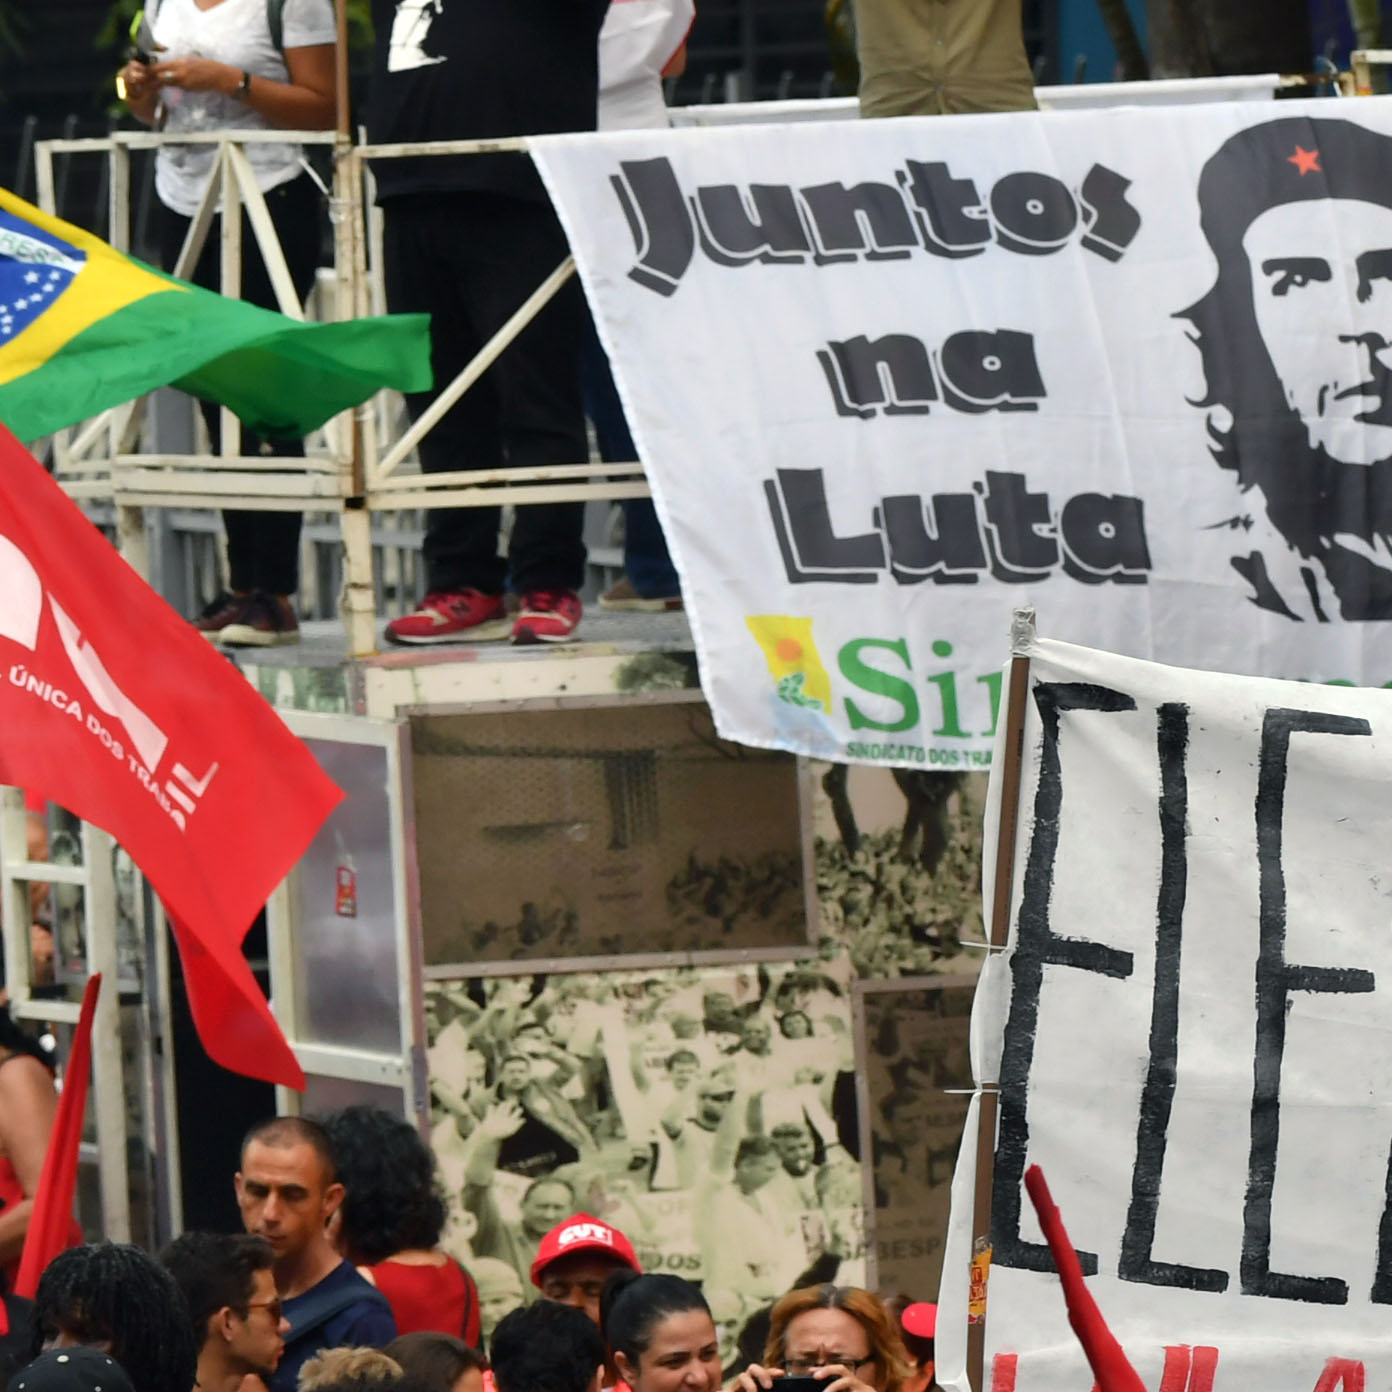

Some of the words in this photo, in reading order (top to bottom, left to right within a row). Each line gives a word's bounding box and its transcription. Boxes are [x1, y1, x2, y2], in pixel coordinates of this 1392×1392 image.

[609, 156, 1143, 297] Juntos
[816, 329, 1049, 419] na
[764, 468, 1153, 586] Luta
[8, 664, 84, 723] ÚNICA
[86, 713, 124, 760] DOS
[845, 740, 926, 763] SINDICATO
[929, 747, 963, 765] DOS
[558, 1222, 609, 1246] CUT
